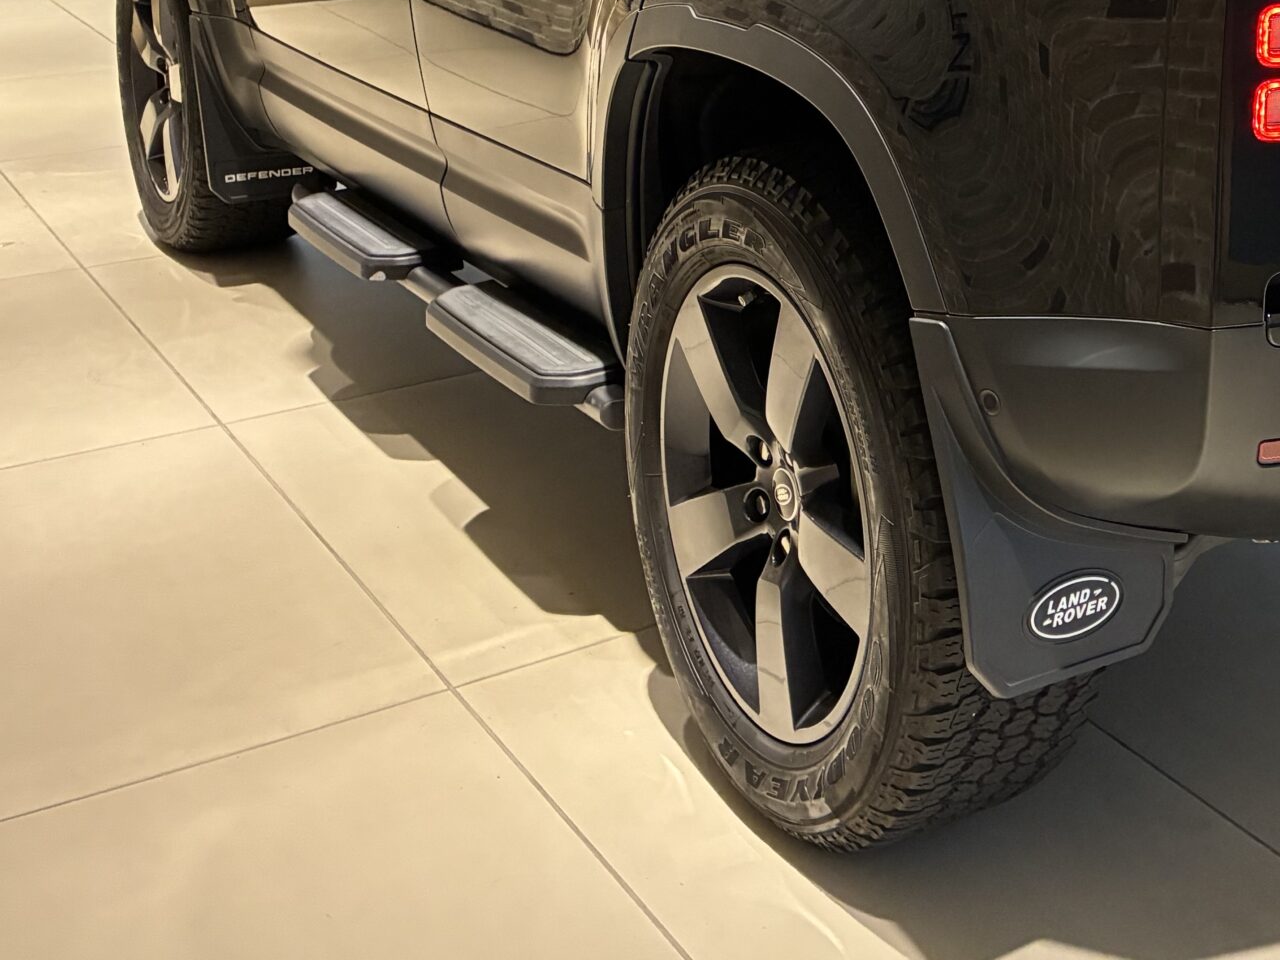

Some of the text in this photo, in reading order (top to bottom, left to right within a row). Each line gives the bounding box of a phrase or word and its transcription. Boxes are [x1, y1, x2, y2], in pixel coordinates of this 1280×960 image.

[224, 166, 314, 184] DEFENDER
[629, 217, 768, 379] WRANGLER
[1047, 588, 1091, 615] LAND
[1052, 596, 1108, 628] ROVER
[714, 639, 884, 803] GOODYEAR
